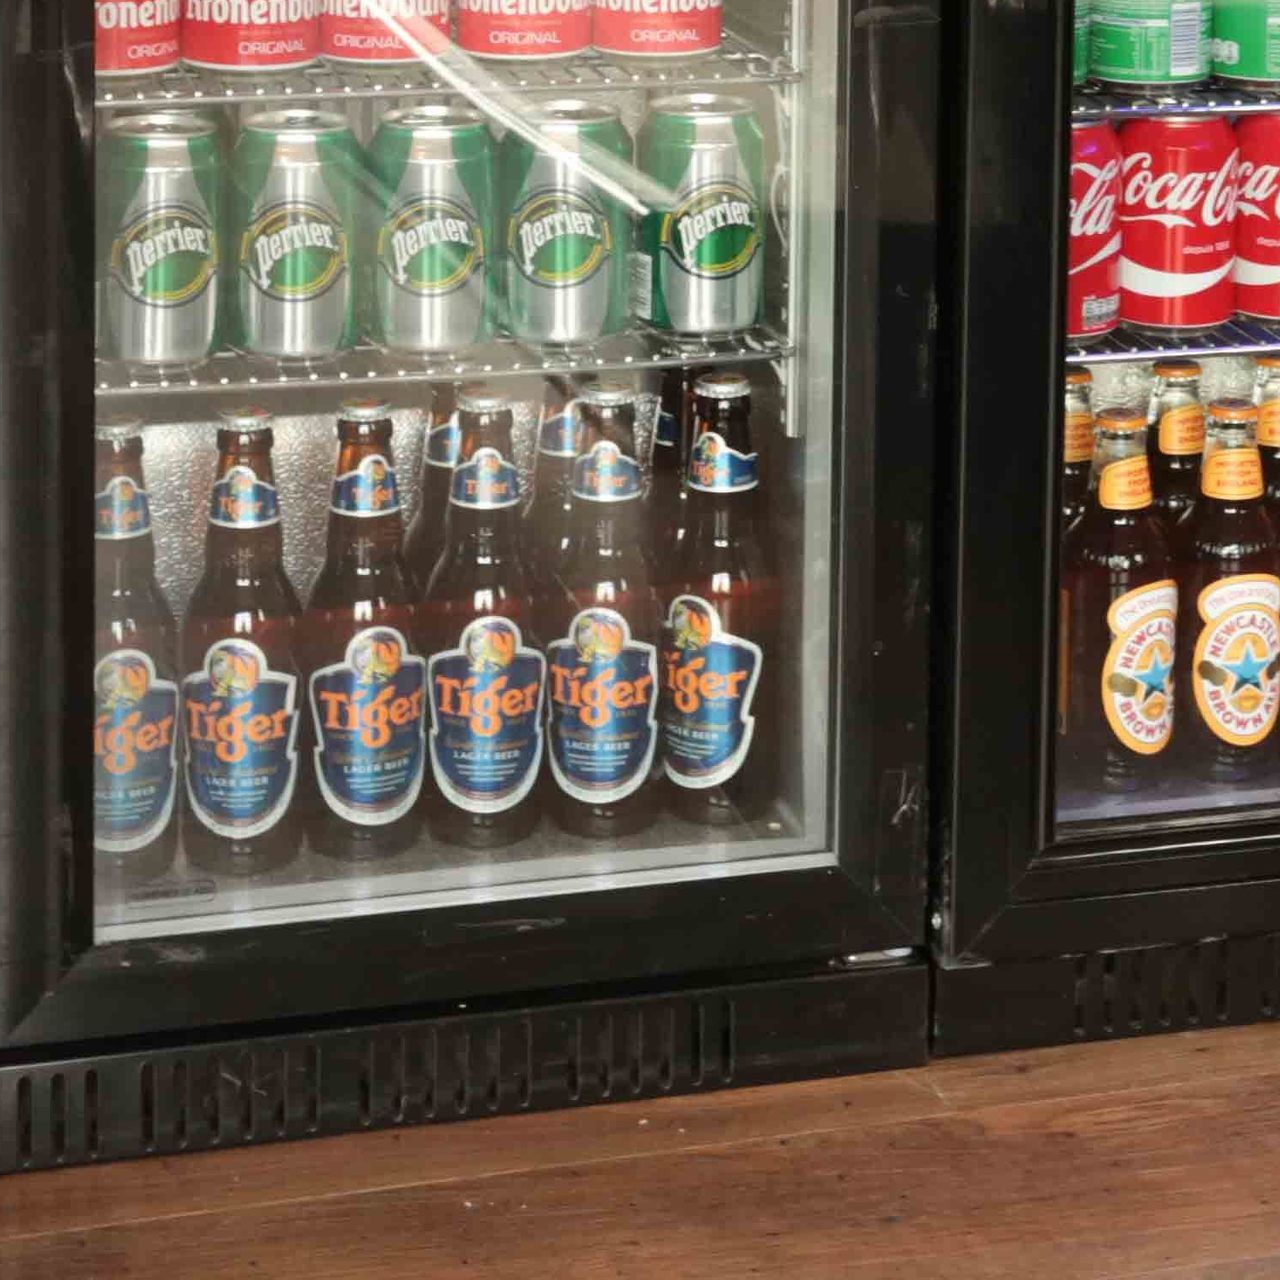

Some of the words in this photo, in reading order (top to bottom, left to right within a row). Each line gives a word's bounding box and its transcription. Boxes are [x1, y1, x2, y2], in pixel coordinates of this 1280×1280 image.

[238, 37, 308, 56] ORIGINAL
[334, 33, 405, 51] ORIGINAL
[489, 28, 562, 45] ORIGINAL
[631, 27, 700, 44] ORIGINAL
[435, 673, 543, 737] Tiger
[550, 663, 655, 728] Tiger
[185, 699, 290, 763] Tiger
[319, 685, 425, 749] Tiger
